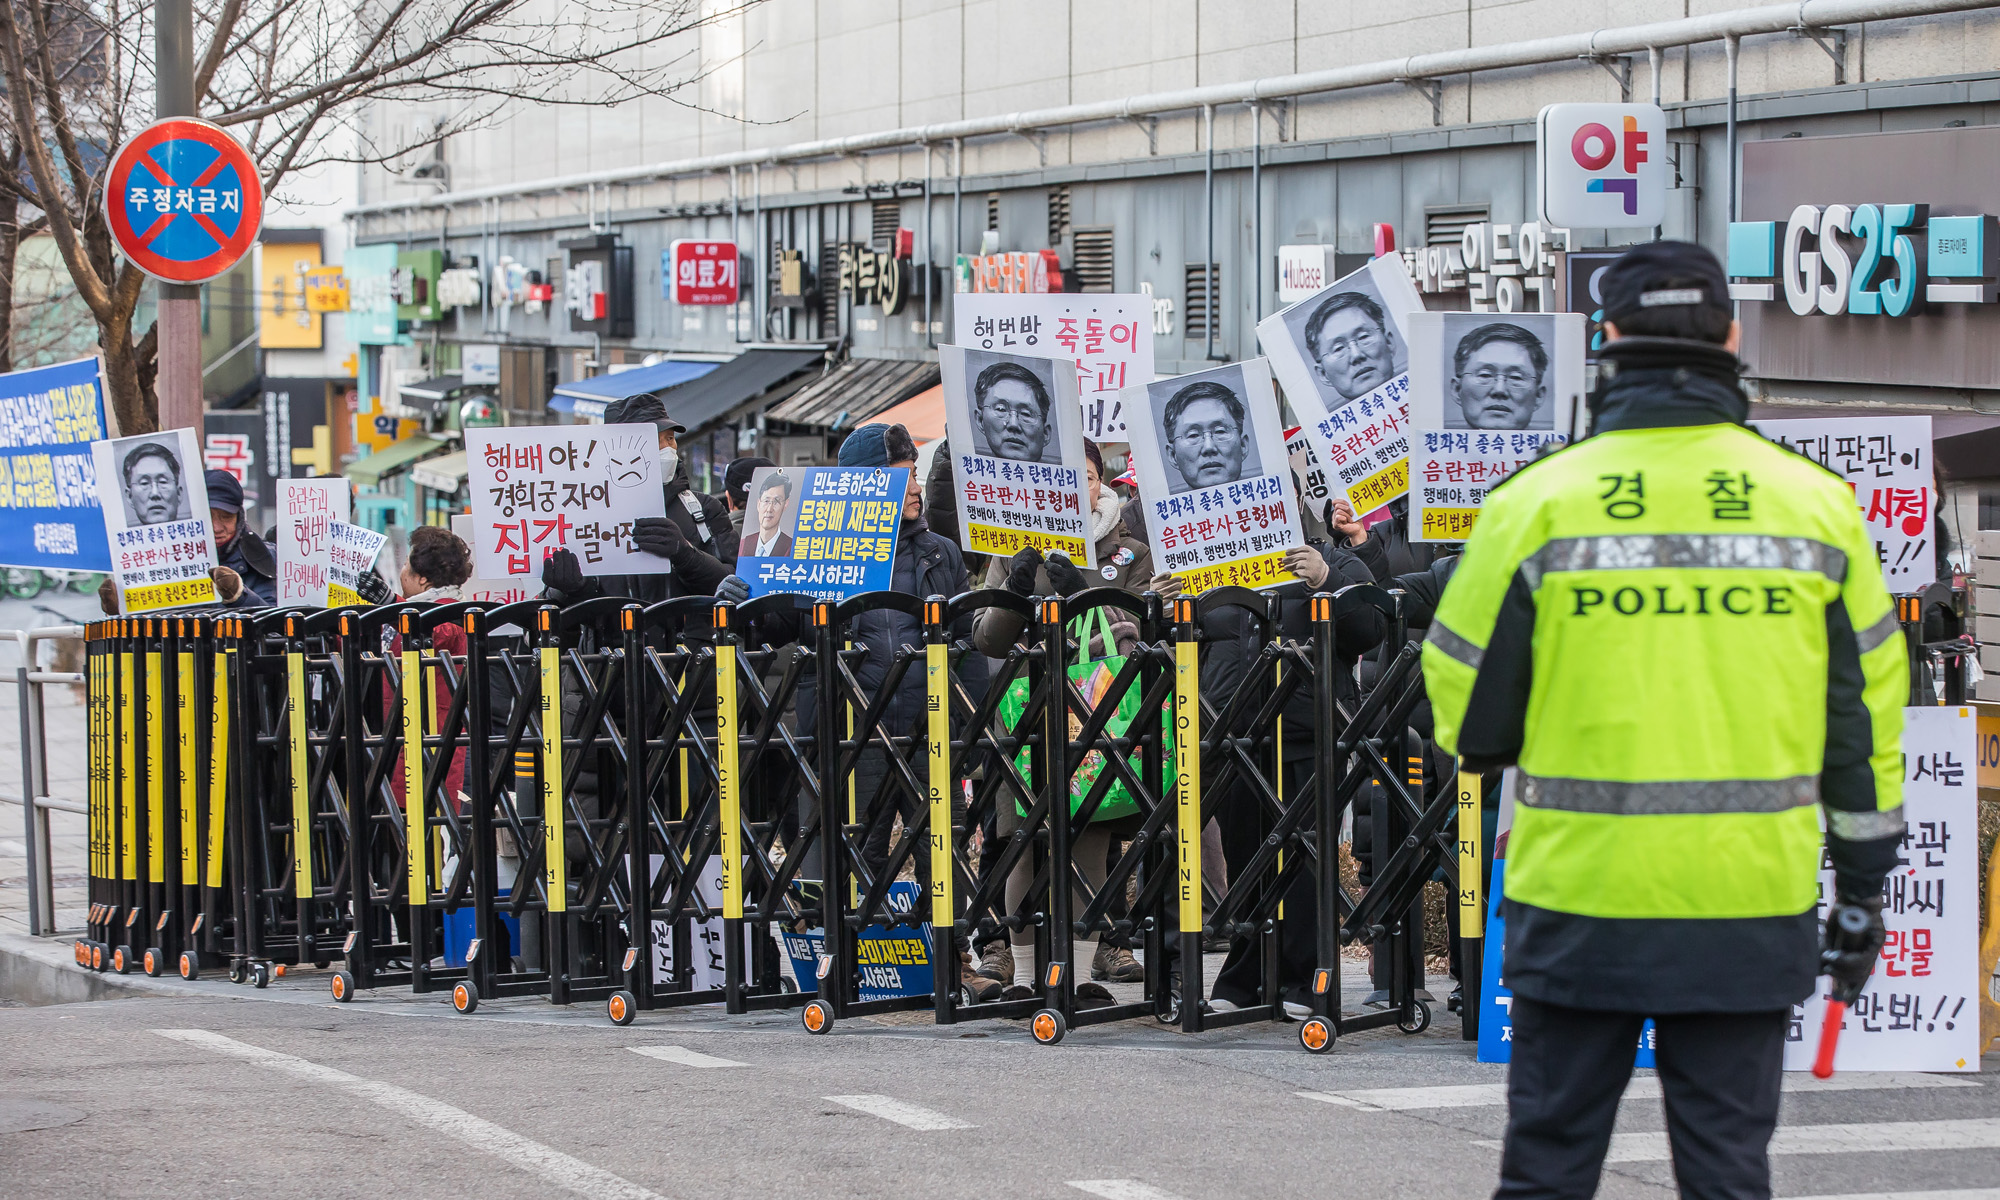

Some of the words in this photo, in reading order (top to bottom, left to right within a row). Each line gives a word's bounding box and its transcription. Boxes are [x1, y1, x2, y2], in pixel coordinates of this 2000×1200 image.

[1571, 115, 1648, 215] 약
[129, 187, 239, 213] 주정차금지
[679, 259, 735, 289] 의료기
[1783, 203, 1916, 317] GS25
[974, 315, 1041, 349] 행번방
[1055, 317, 1138, 354] 죽돌이
[1318, 406, 1358, 439] 편파적
[1359, 392, 1385, 417] 졸속
[1424, 432, 1469, 454] 편파적
[1475, 433, 1506, 454] 졸속
[812, 472, 891, 497] 민노총하수인
[962, 456, 996, 478] 편파적
[1000, 462, 1025, 483] 졸속
[1028, 465, 1078, 489] 탄핵심리
[1339, 457, 1377, 484] 행배야,
[287, 486, 328, 515] 음란수괴
[1156, 494, 1195, 520] 편파적
[1200, 489, 1224, 511] 졸속
[1228, 475, 1283, 506] 탄핵심리
[1352, 468, 1404, 508] 우리법회장
[1423, 487, 1465, 504] 행배야,
[798, 500, 846, 532] 문형배
[847, 501, 898, 533] 재판관
[966, 505, 1000, 524] 행배야,
[1002, 510, 1042, 529] 행번방서
[1423, 512, 1479, 533] 우리법회
[117, 528, 145, 547] 편파적
[148, 526, 164, 543] 졸속
[167, 520, 205, 540] 탄핵심리
[294, 511, 335, 557] 행번
[970, 527, 1019, 550] 우리법회장
[793, 536, 892, 562] 불법내란주동
[1165, 549, 1203, 569] 행배야,
[1203, 539, 1249, 562] 행번방서
[758, 563, 866, 585] 구속수사하라!
[1228, 561, 1261, 586] 출신은
[126, 588, 162, 606] 우리법회장
[165, 585, 188, 602] 출신은
[1573, 586, 1793, 616] POLICE
[1178, 695, 1191, 806] POLICE
[927, 694, 945, 898] 질서유지선
[721, 821, 730, 890] LINE
[1181, 828, 1191, 901] LINE
[859, 967, 903, 989] 사하라
